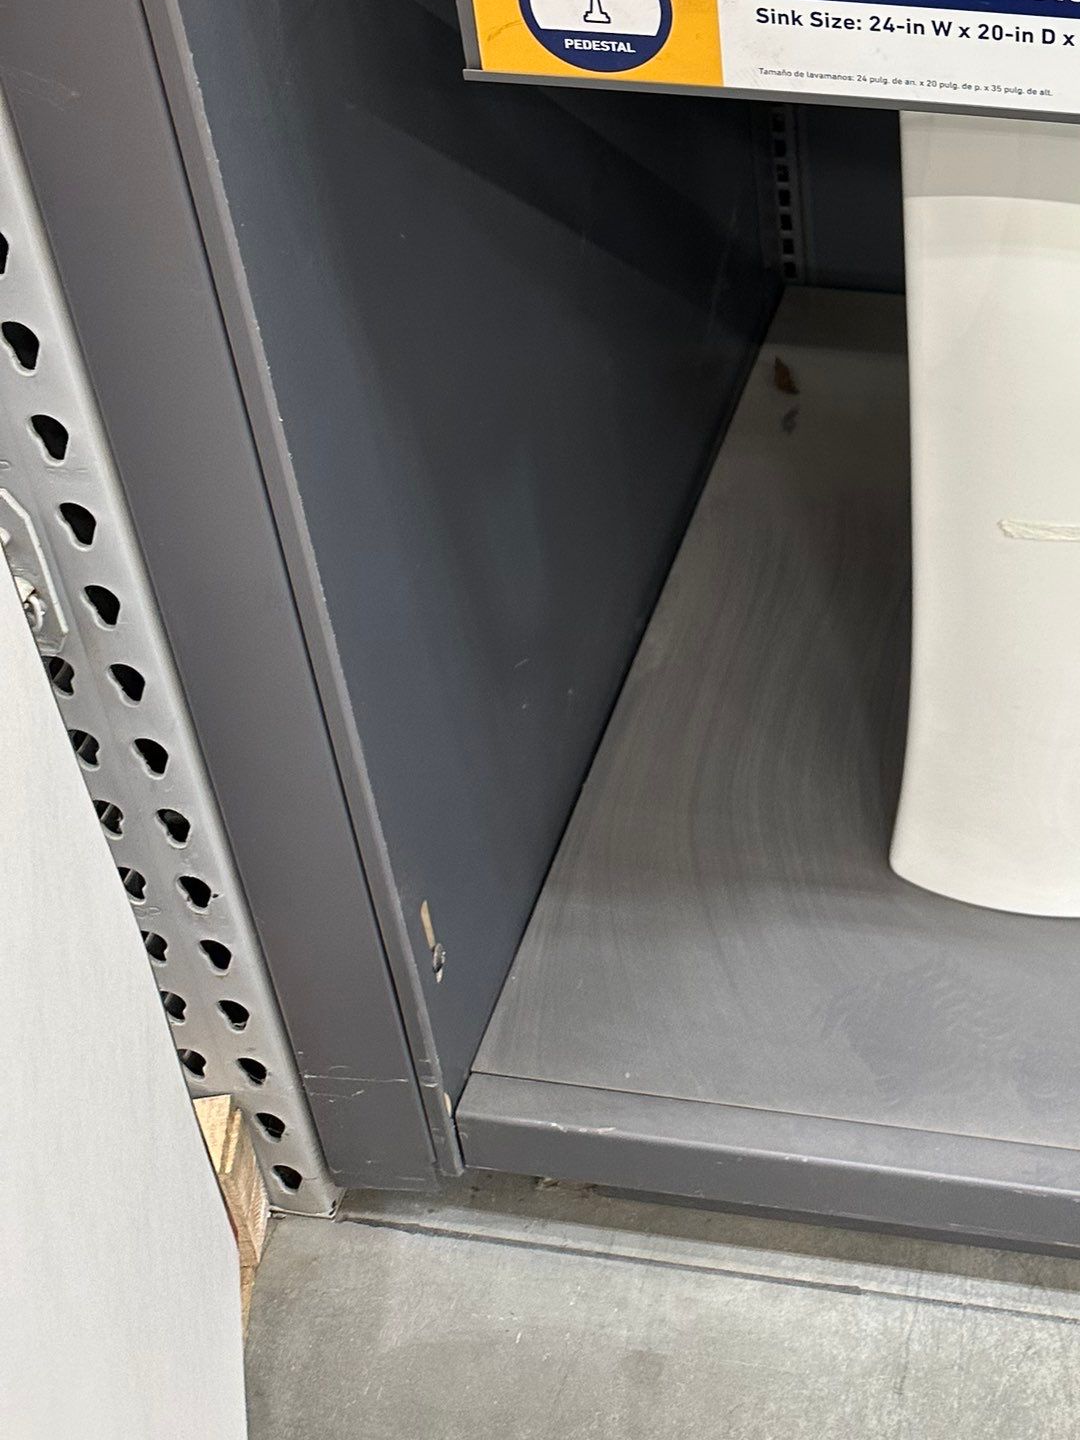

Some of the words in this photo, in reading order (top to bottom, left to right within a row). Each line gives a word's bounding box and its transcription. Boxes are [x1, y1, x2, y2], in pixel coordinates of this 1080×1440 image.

[756, 8, 804, 26] Sink
[810, 11, 862, 31] Size:
[869, 16, 925, 35] 24-in
[931, 20, 952, 37] W
[958, 26, 970, 39] x
[978, 23, 1034, 43] 20-in
[1041, 28, 1056, 45] D
[1062, 34, 1075, 47] x
[564, 38, 636, 53] PEDESTAL
